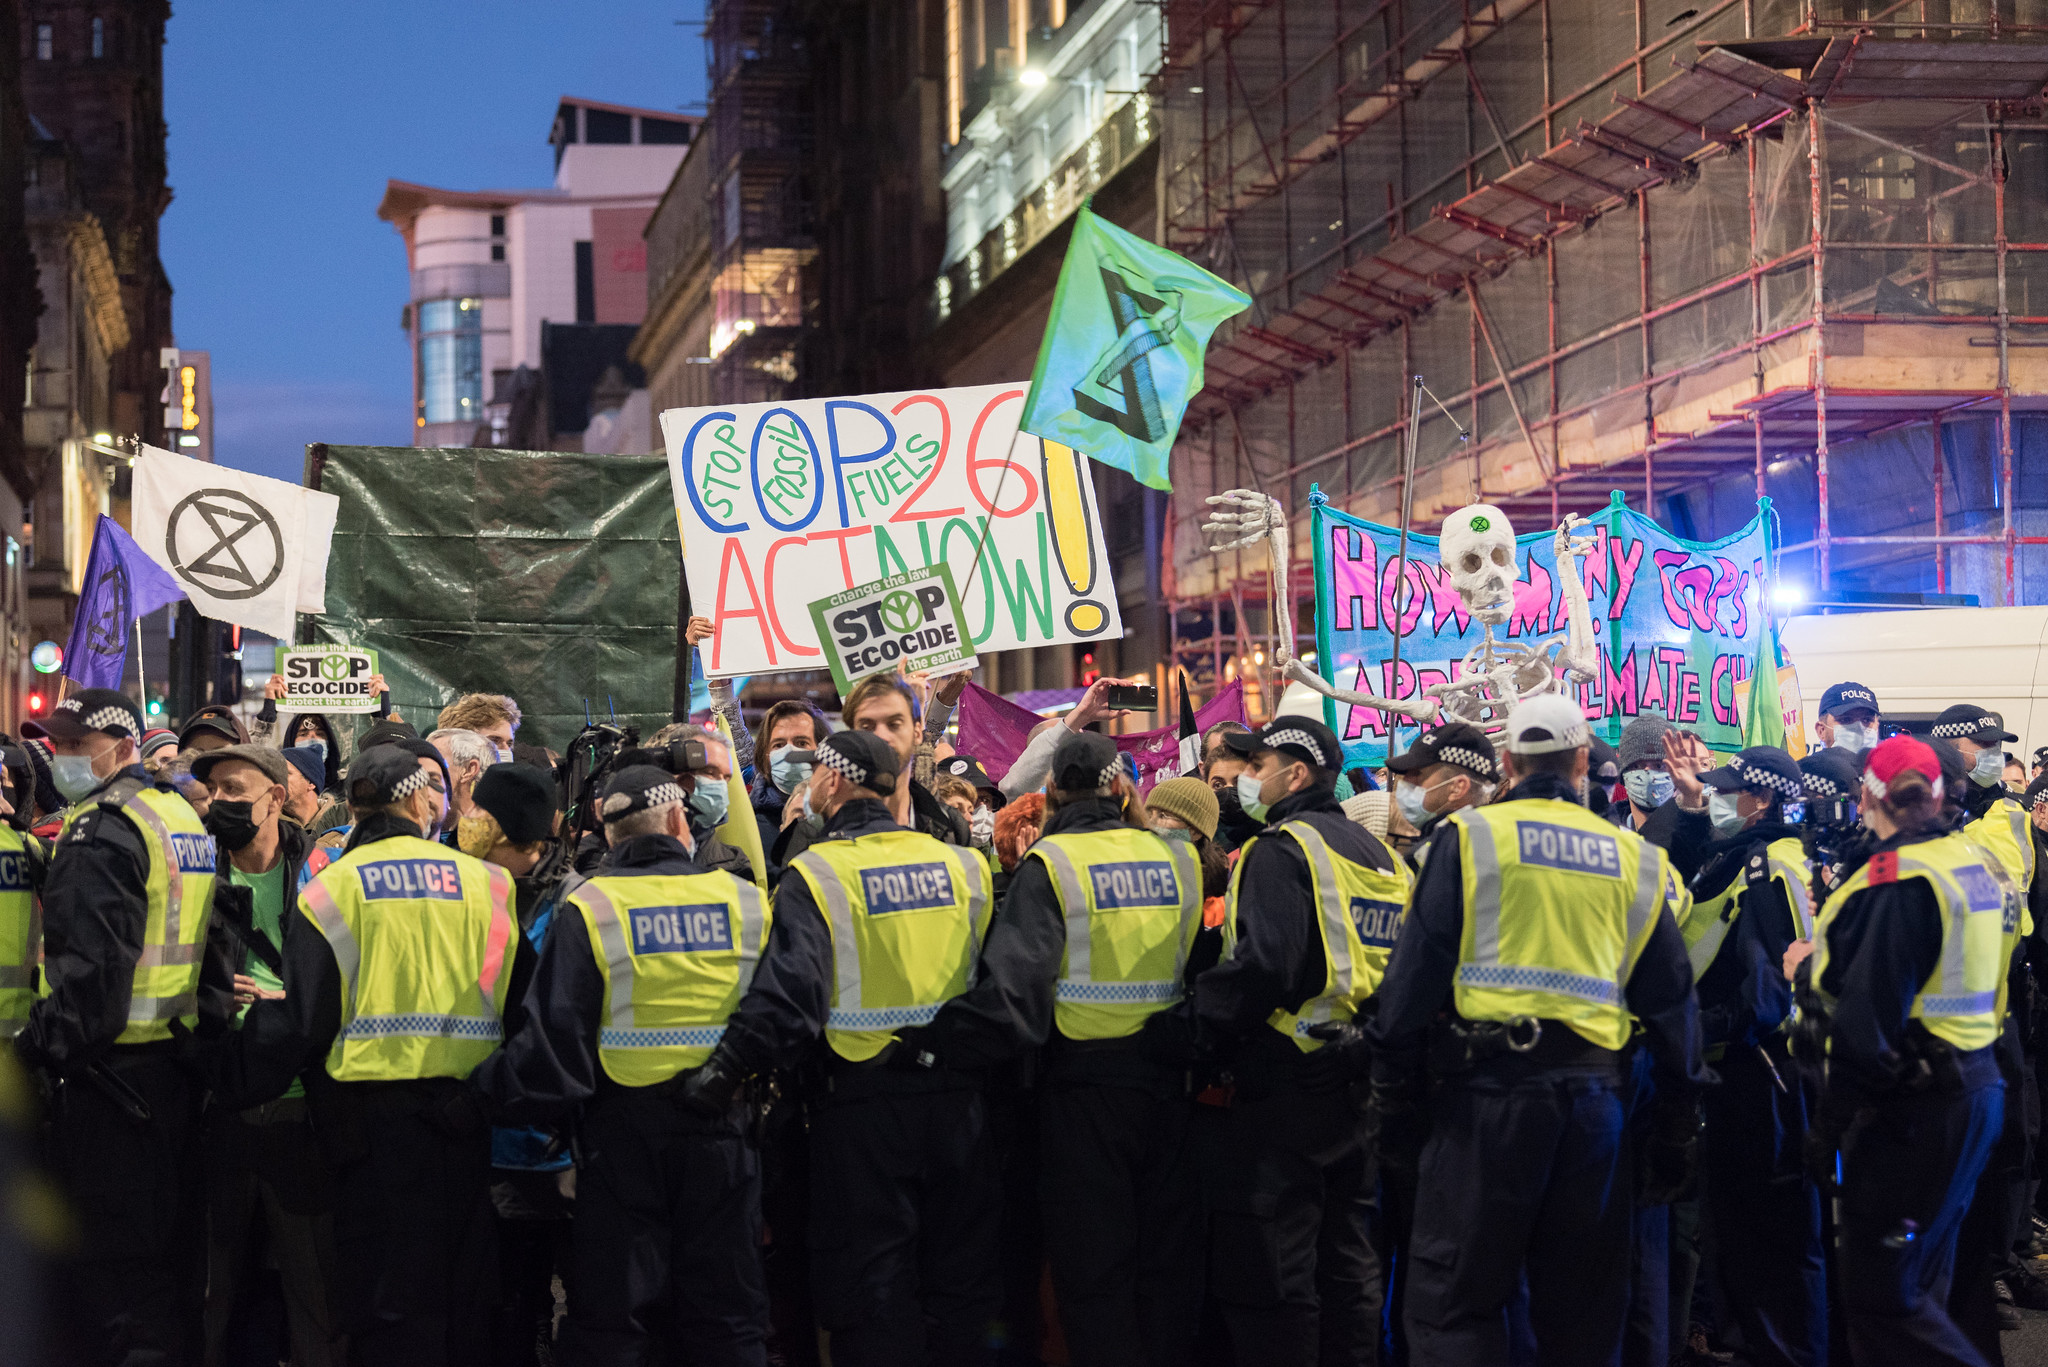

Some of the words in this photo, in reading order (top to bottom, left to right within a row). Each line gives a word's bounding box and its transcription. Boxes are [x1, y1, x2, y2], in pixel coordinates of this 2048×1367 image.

[682, 390, 1038, 533] COP26
[702, 424, 747, 518] STOP
[847, 433, 940, 518] FUELS
[711, 525, 871, 670] ACT
[830, 581, 881, 606] change
[883, 573, 906, 589] the
[908, 567, 930, 583] law
[1332, 525, 1472, 639] HOW
[1653, 549, 1749, 639] COPS
[291, 645, 327, 653] change
[330, 644, 346, 652] the
[348, 644, 364, 653] law
[844, 624, 957, 674] ECOCIDE
[907, 656, 928, 671] the
[931, 648, 963, 666] earth
[286, 698, 322, 707] protect
[325, 698, 341, 706] the
[287, 682, 370, 695] ECOCIDE
[1841, 690, 1872, 702] POLICE
[1522, 827, 1618, 869] POLICE
[364, 860, 457, 897] POLICE
[866, 868, 951, 909] POLICE
[1093, 867, 1176, 901] POLICE
[636, 910, 726, 948] POLICE
